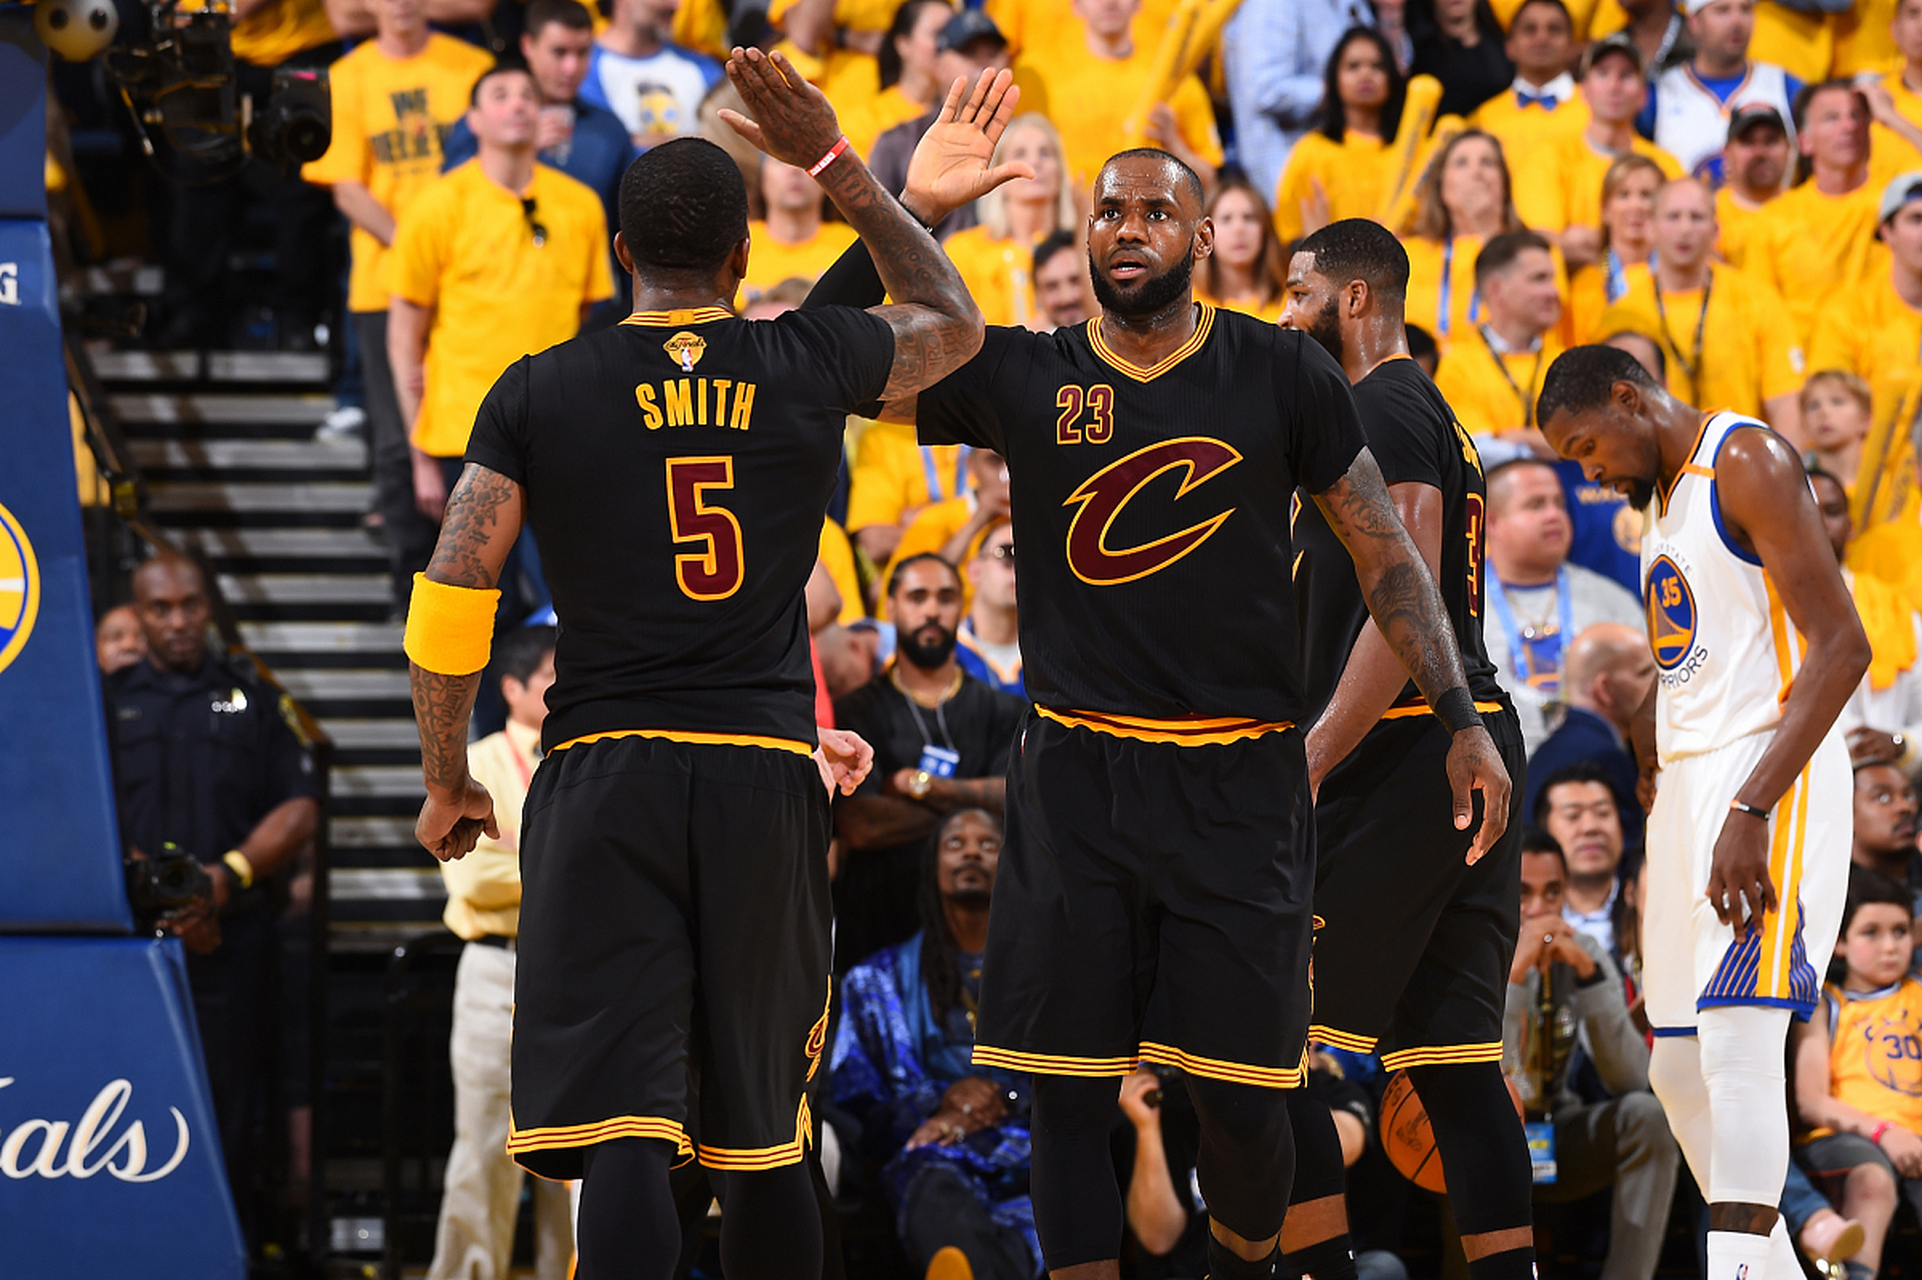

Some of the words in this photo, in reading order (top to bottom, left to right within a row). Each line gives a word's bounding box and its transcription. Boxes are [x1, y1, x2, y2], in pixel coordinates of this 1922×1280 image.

[635, 378, 757, 431] SMITH
[1056, 384, 1115, 445] 23
[665, 455, 746, 601] 5
[1660, 575, 1683, 608] 35
[1660, 644, 1709, 690] RRIORS
[1882, 1033, 1921, 1060] 30
[0, 1077, 190, 1183] als
